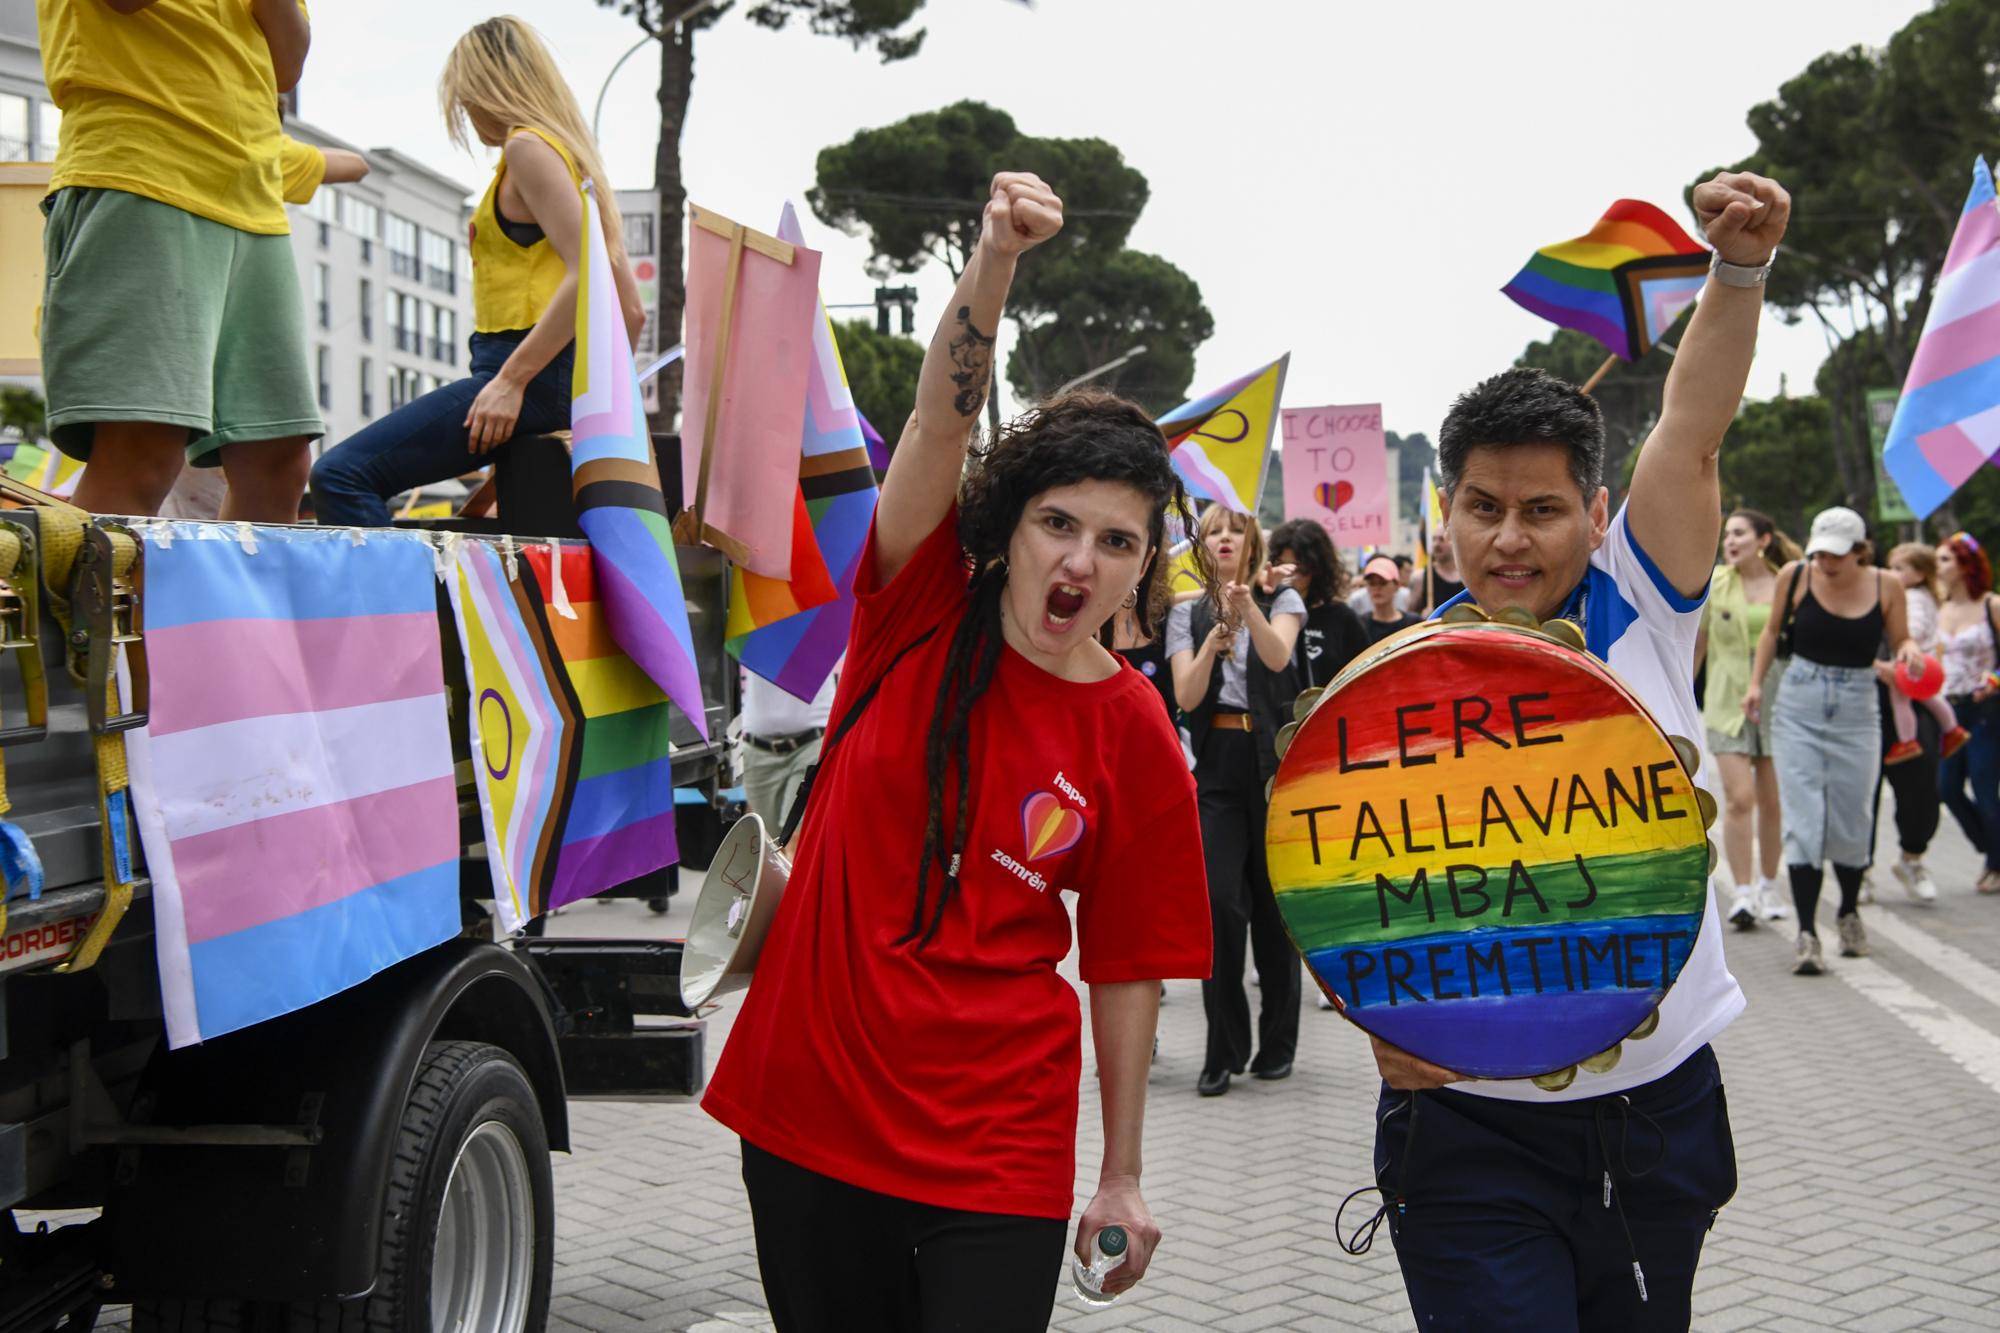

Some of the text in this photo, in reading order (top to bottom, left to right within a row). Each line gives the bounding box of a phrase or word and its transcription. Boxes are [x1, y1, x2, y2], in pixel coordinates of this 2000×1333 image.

[1283, 413, 1380, 440] I CHOOSE
[1306, 446, 1355, 473] TO
[1337, 691, 1564, 774] LERE
[1053, 771, 1088, 808] hape
[1290, 760, 1688, 865] TALLAVANE
[990, 848, 1047, 893] zemrën
[1375, 853, 1598, 928] MBAJ
[1341, 930, 1689, 1008] PREMTIMET
